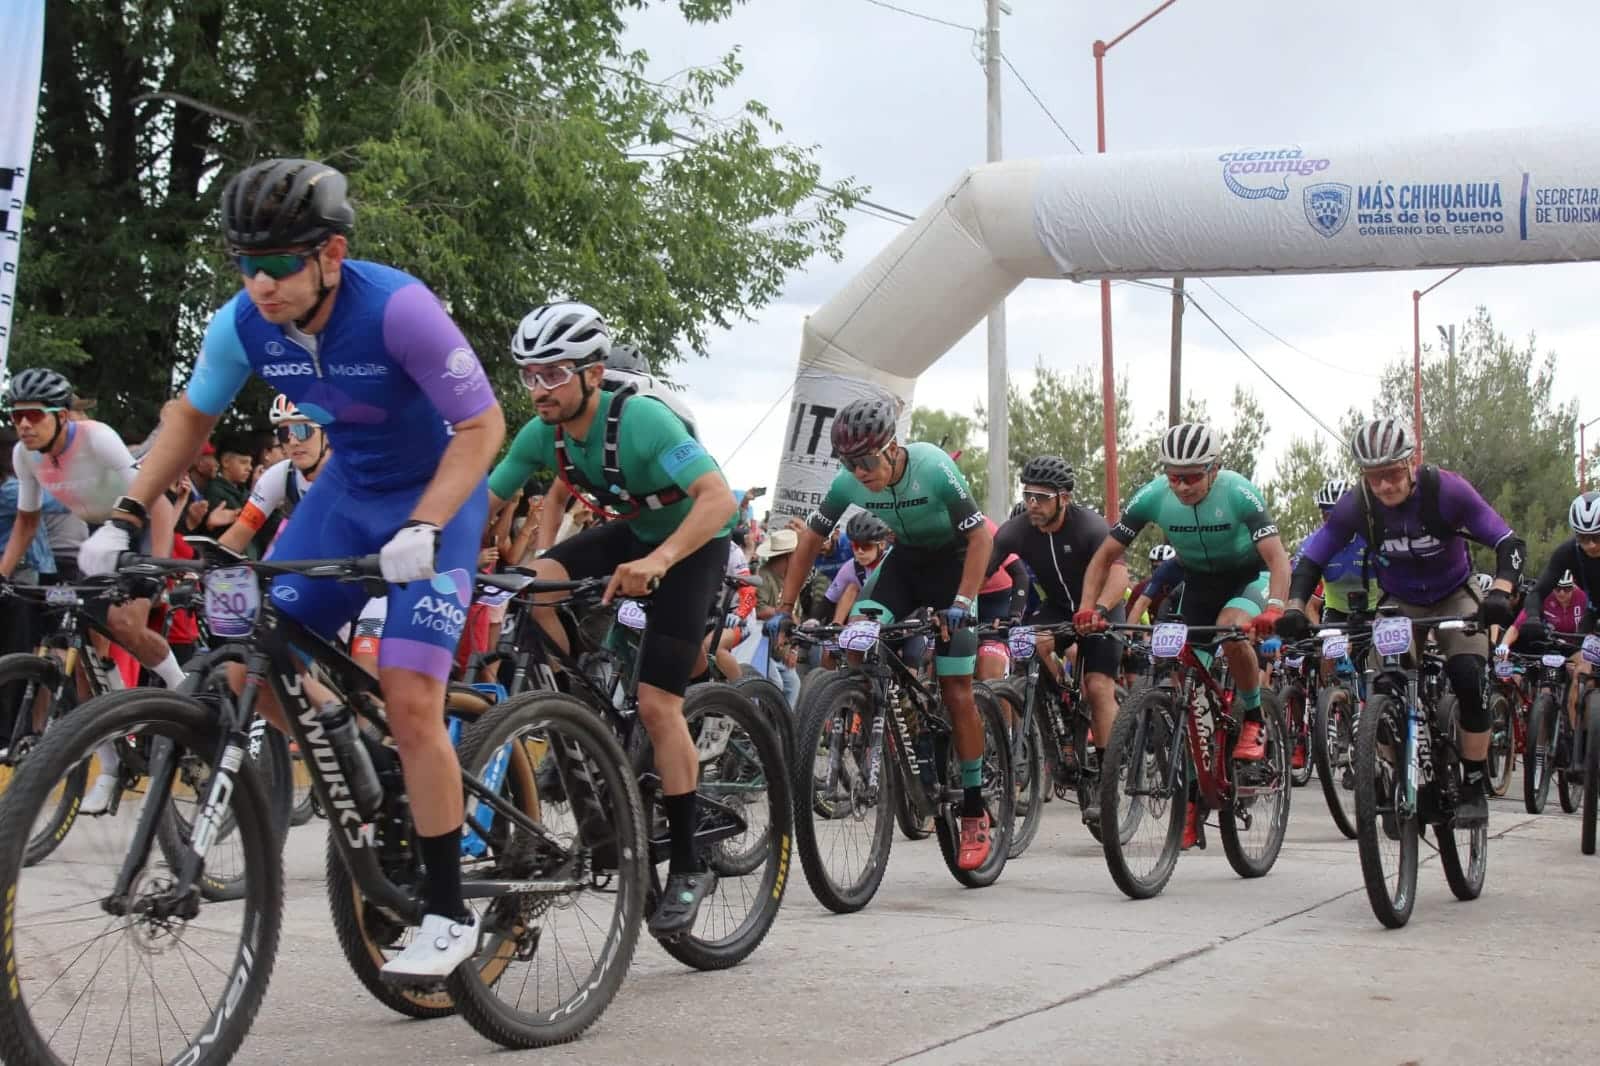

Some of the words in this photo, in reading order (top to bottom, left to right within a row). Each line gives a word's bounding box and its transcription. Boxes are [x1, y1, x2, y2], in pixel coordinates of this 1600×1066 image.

[1217, 148, 1304, 162] cuenta
[1228, 157, 1330, 177] conmigo
[1357, 180, 1394, 210] MÁS
[1400, 182, 1503, 209] CHIHUAHUA
[1357, 210, 1393, 224] más
[1398, 210, 1420, 224] de
[1425, 210, 1441, 223] lo
[1446, 209, 1504, 223] bueno
[1535, 207, 1552, 224] DE
[1358, 226, 1423, 237] GOBIERNO
[1426, 225, 1450, 236] DEL
[1454, 224, 1505, 235] ESTADO
[327, 362, 390, 378] Mobile
[413, 595, 466, 625] AXIO
[1153, 634, 1183, 648] 1078
[1375, 629, 1410, 645] 1093
[281, 671, 369, 849] S-WORKS
